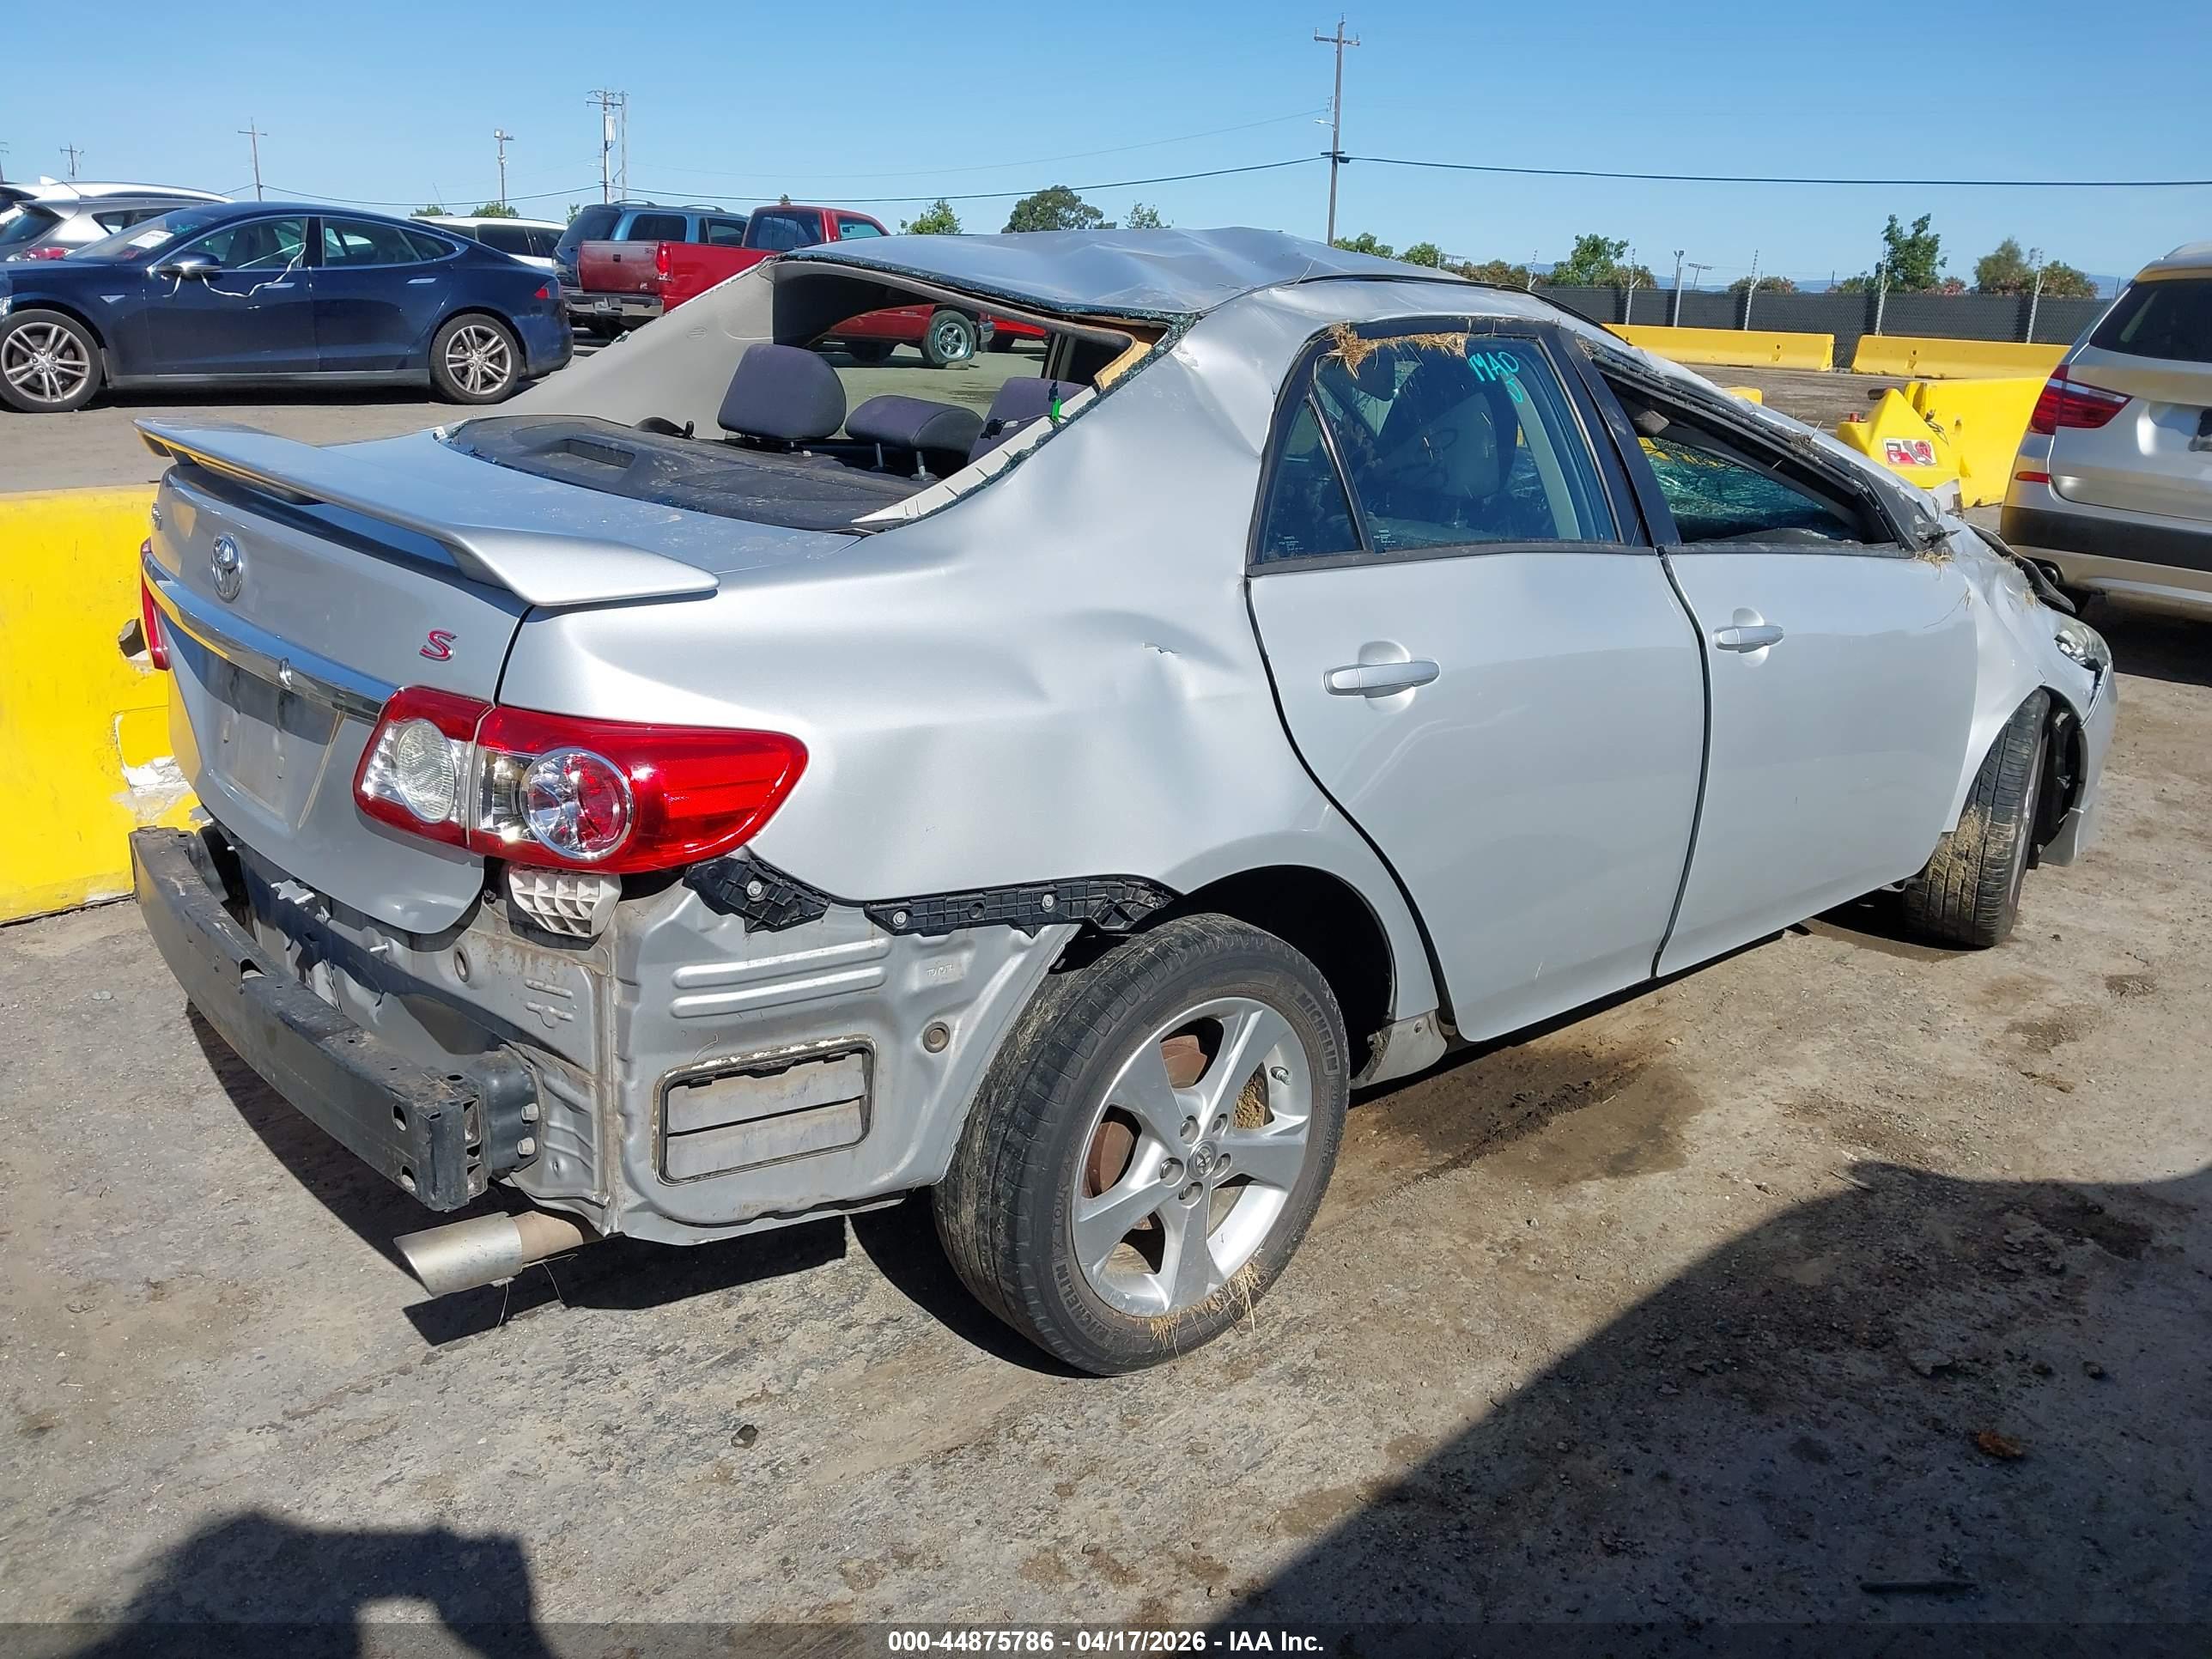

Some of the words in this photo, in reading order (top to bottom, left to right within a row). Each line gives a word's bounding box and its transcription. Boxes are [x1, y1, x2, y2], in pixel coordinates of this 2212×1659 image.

[1468, 351, 1519, 382] MAD
[419, 628, 458, 662] S
[1297, 992, 1340, 1072] MICHELIN
[1053, 1182, 1068, 1231] TOUR
